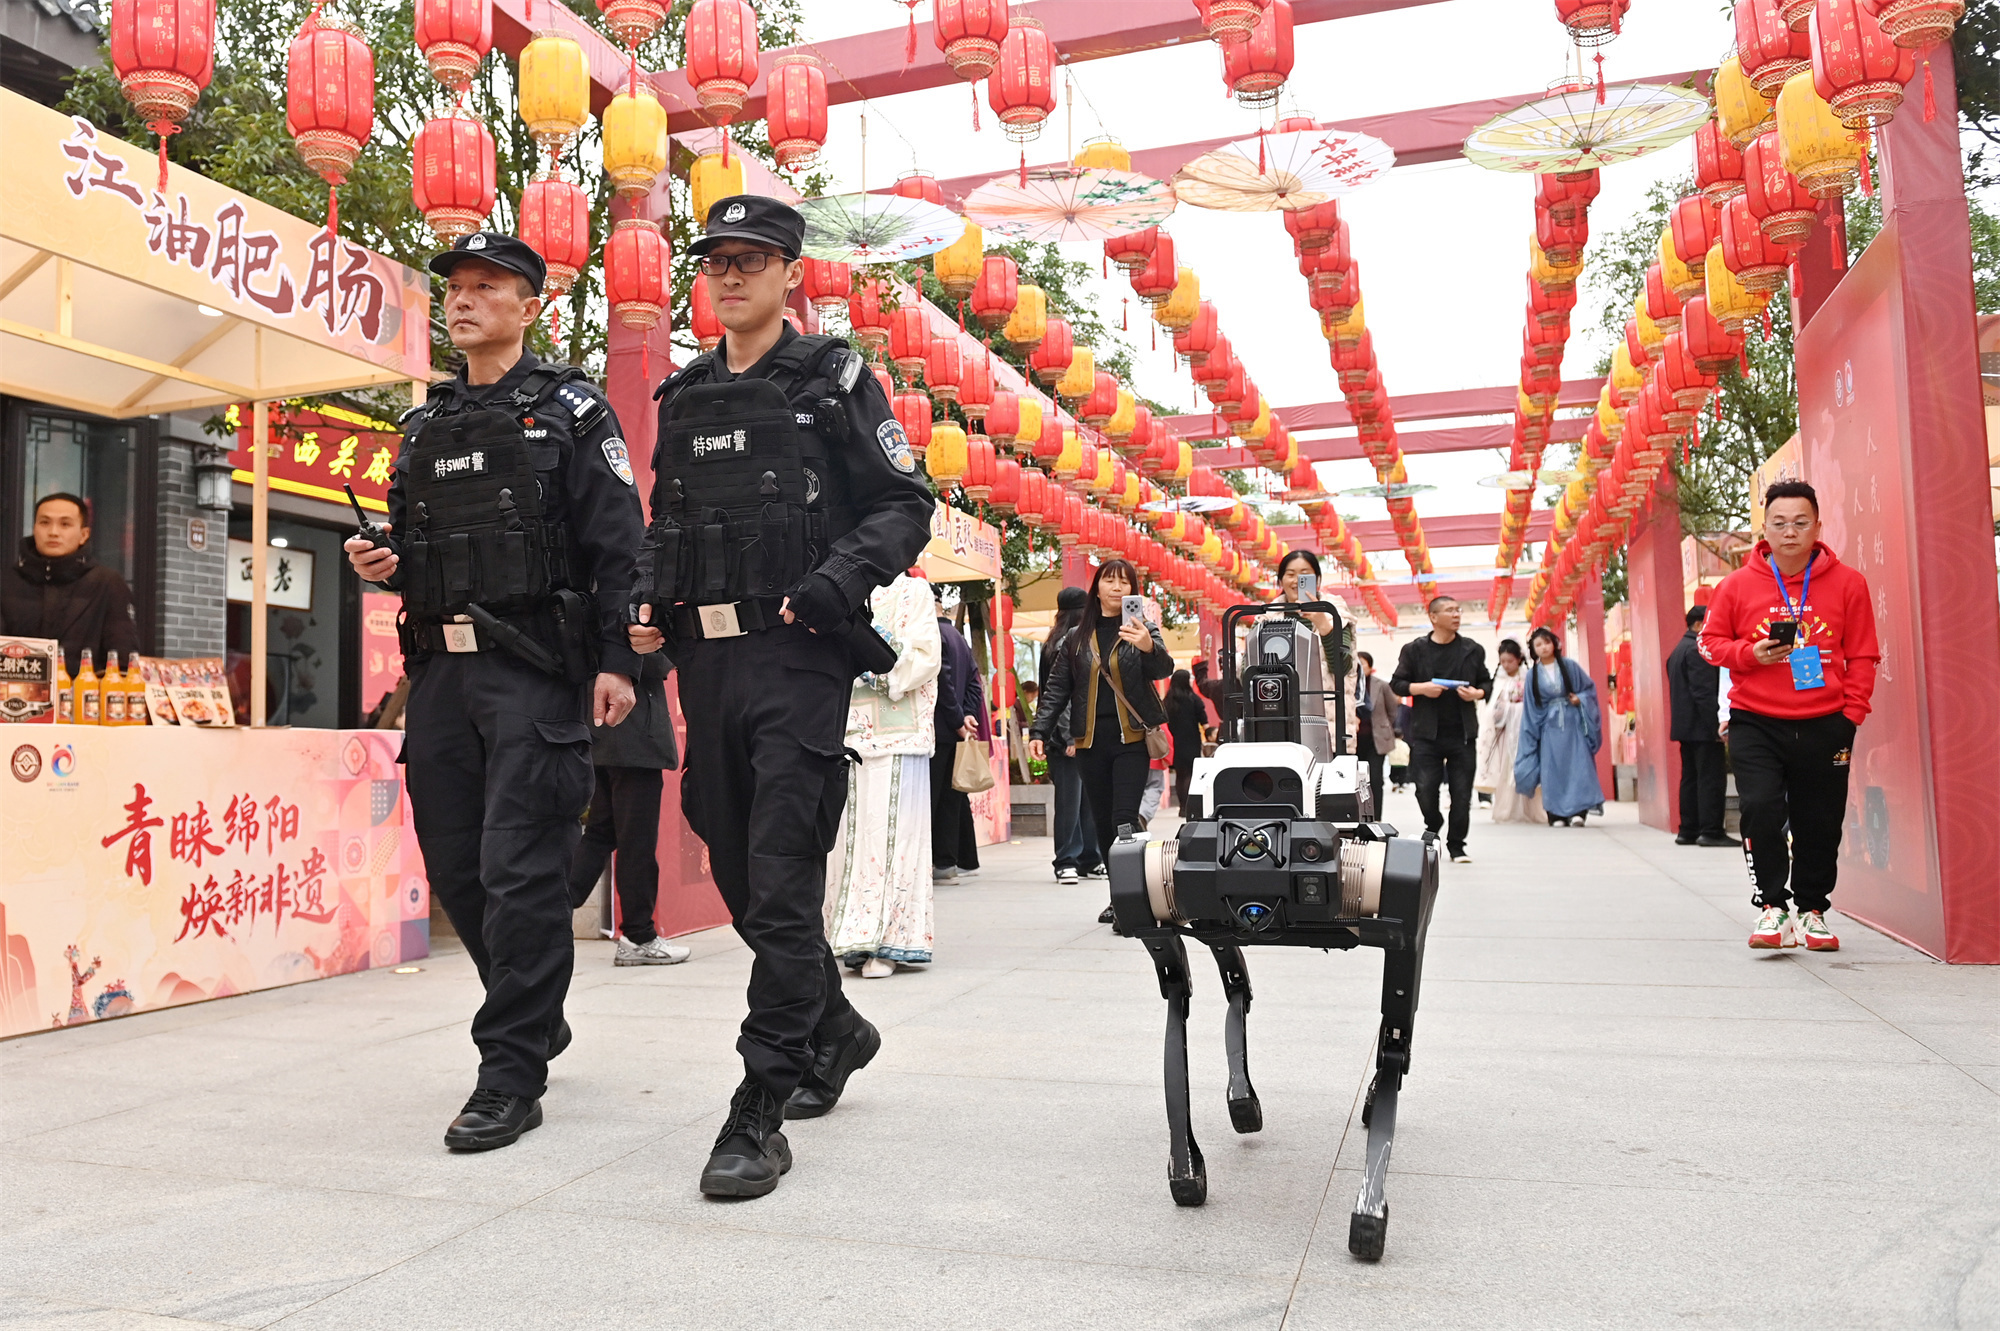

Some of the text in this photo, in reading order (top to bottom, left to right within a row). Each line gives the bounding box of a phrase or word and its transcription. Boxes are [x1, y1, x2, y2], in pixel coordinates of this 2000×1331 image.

[161, 26, 174, 40] 福
[1017, 65, 1041, 87] 福
[1764, 171, 1785, 198] 福
[62, 117, 385, 341] 江油肥肠
[435, 451, 485, 478] 特SWAT警
[692, 429, 746, 457] 特SWAT警
[1853, 487, 1867, 571] 人民
[1867, 426, 1893, 682] 人民的非遗
[101, 783, 299, 886] 青睐绵阳
[173, 847, 343, 944] 焕新非遗
